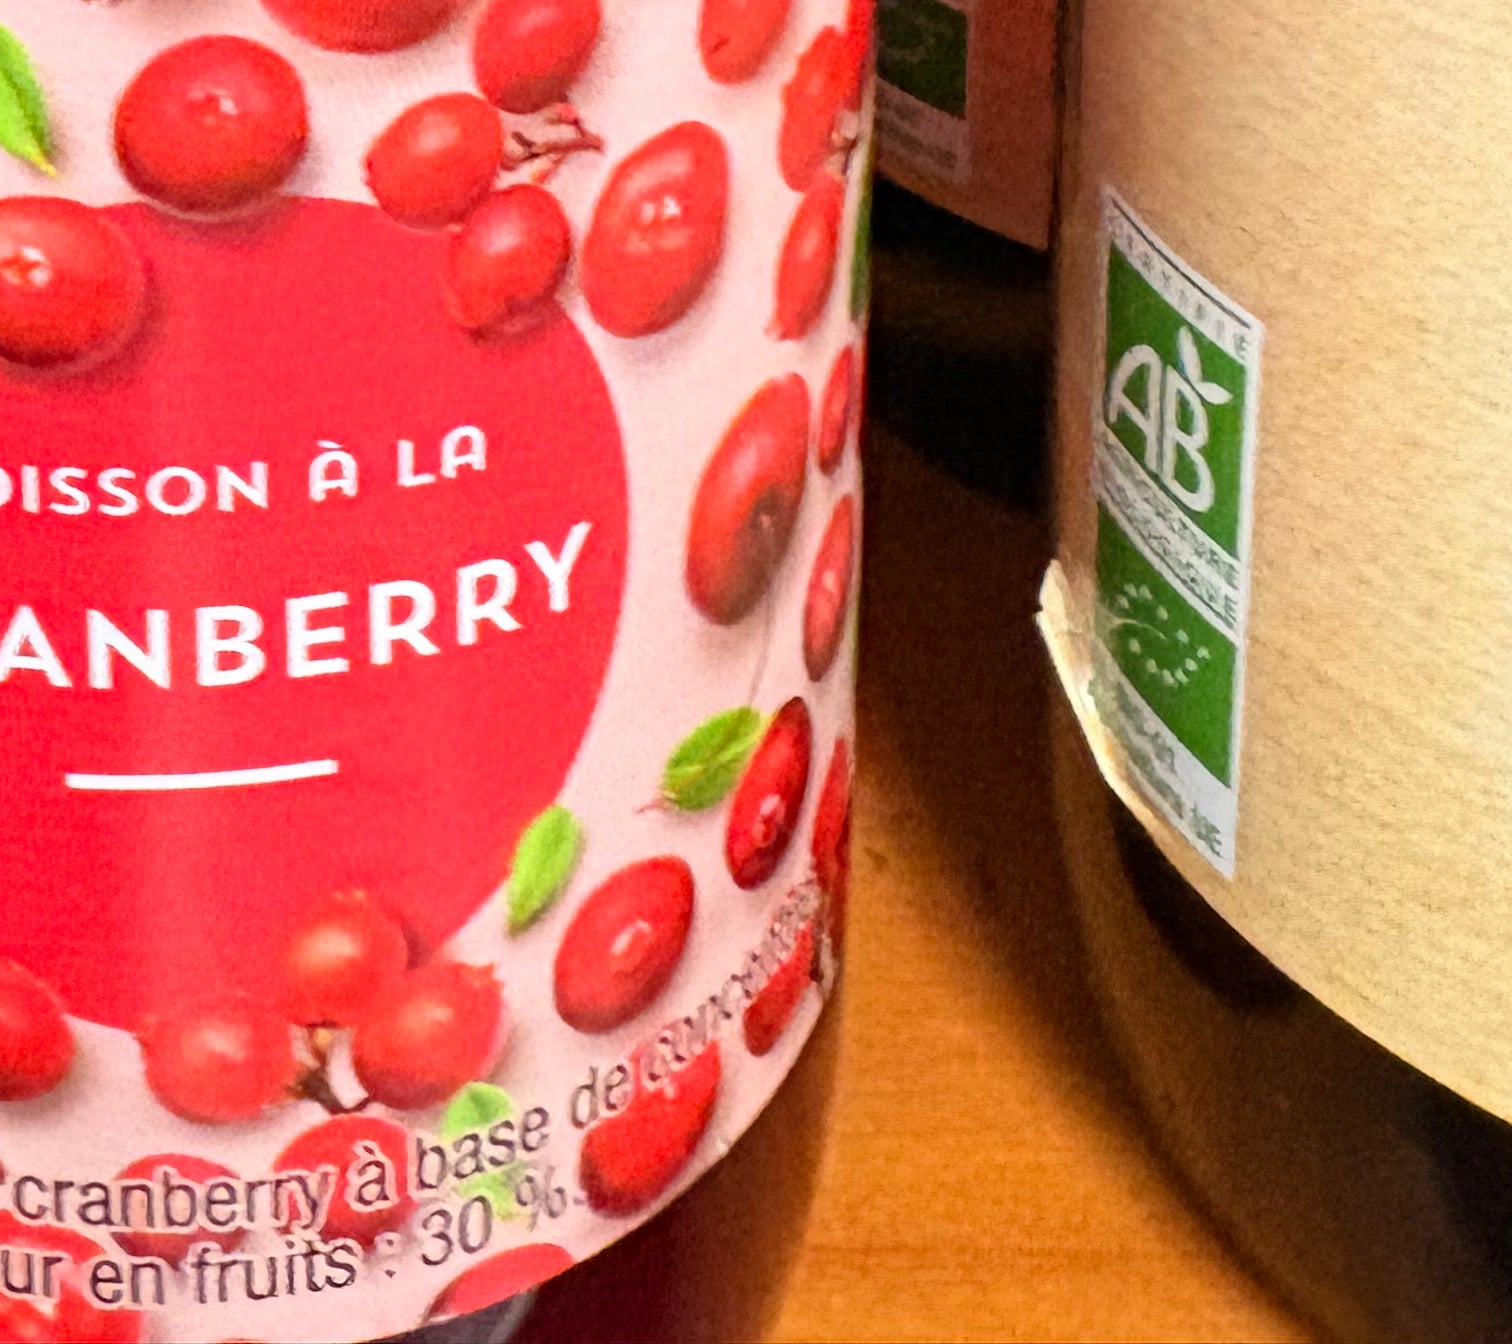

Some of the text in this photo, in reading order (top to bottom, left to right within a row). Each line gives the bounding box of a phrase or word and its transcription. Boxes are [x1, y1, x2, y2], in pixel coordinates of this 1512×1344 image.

[308, 440, 358, 502] À
[396, 425, 486, 487] LA
[1108, 342, 1216, 513] AB
[13, 1169, 333, 1230] cranberry
[357, 1144, 392, 1205] à
[415, 1106, 550, 1190] base
[570, 1064, 630, 1129] de
[91, 1258, 166, 1305] en
[191, 1242, 358, 1304] fruits
[421, 1194, 493, 1266] 30
